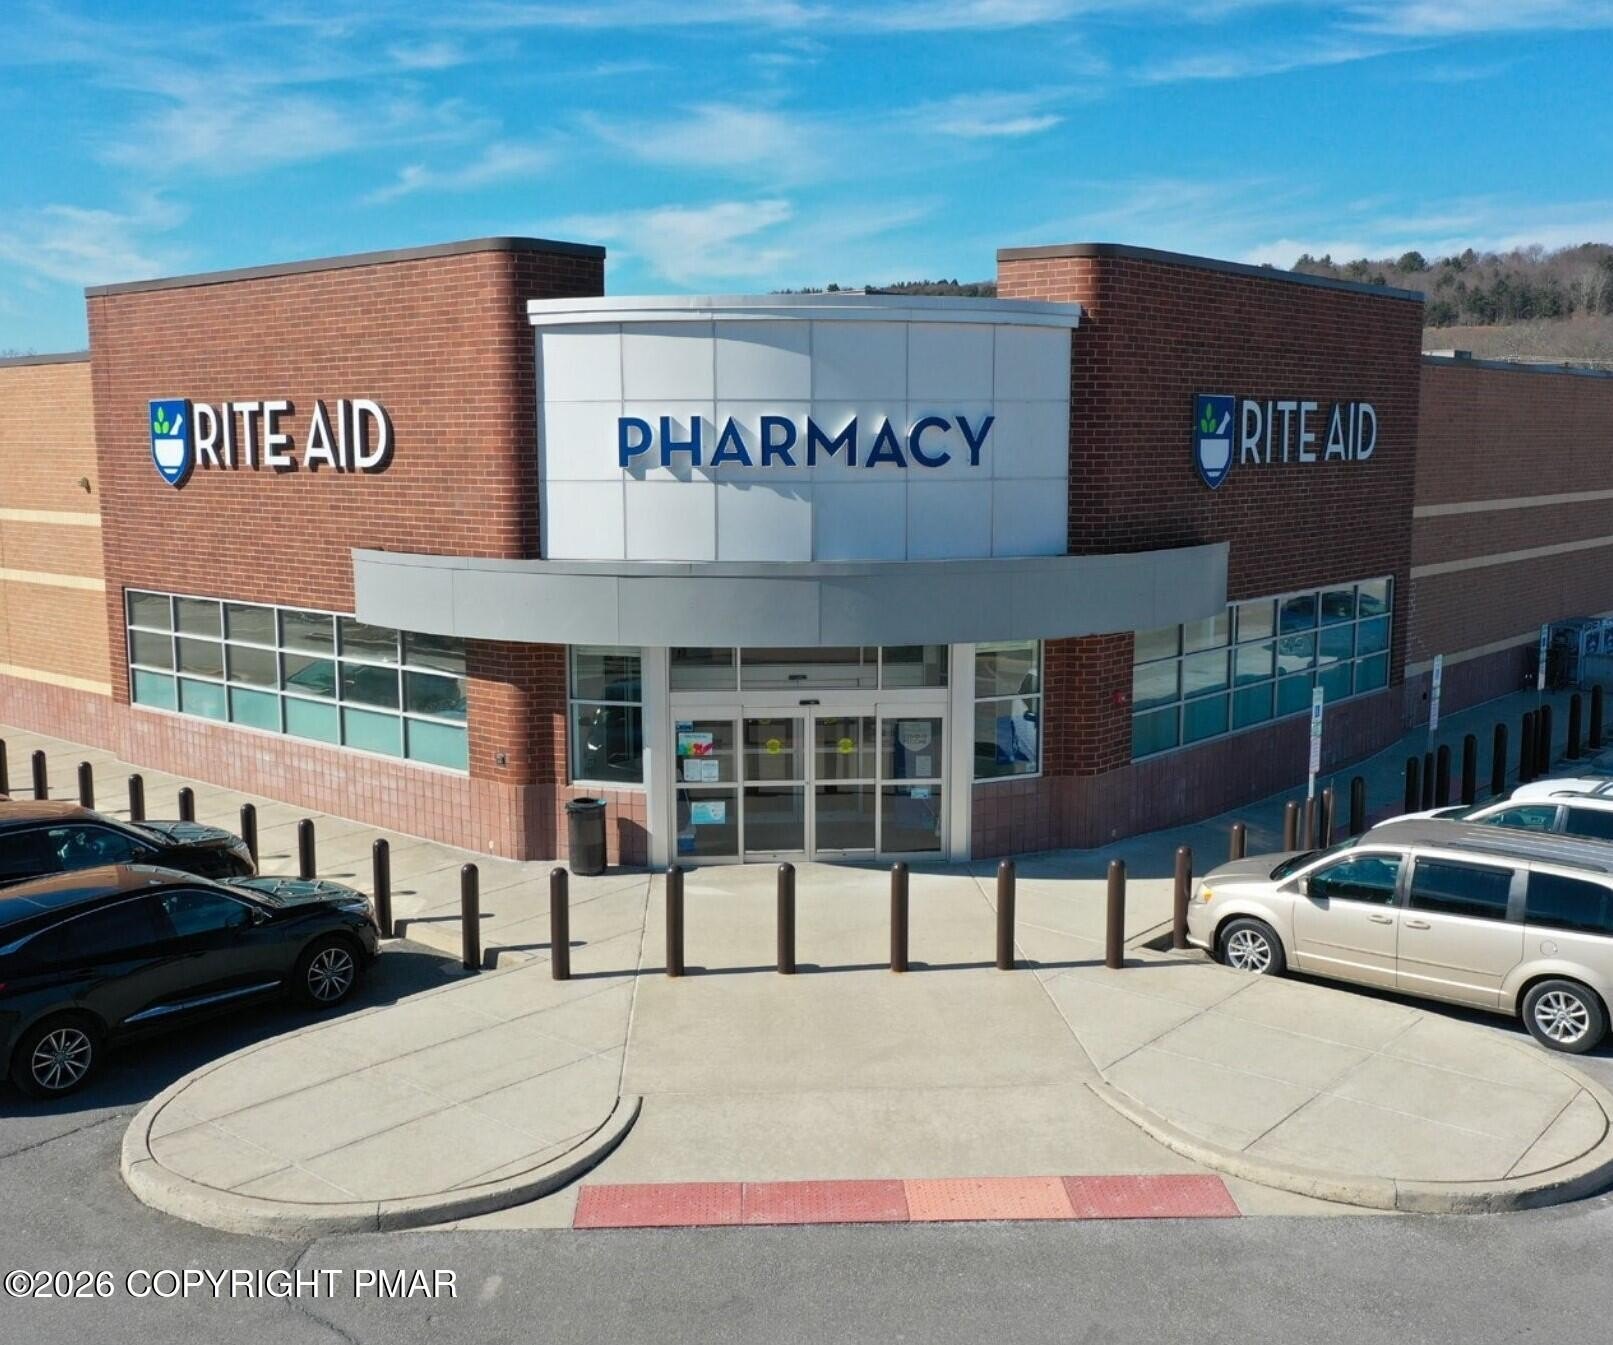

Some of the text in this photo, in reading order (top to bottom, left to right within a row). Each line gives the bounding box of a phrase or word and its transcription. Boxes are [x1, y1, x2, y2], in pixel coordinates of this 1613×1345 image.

[193, 399, 388, 468] RITE AID
[617, 415, 996, 468] PHARMACY
[1240, 399, 1378, 465] RITE AID
